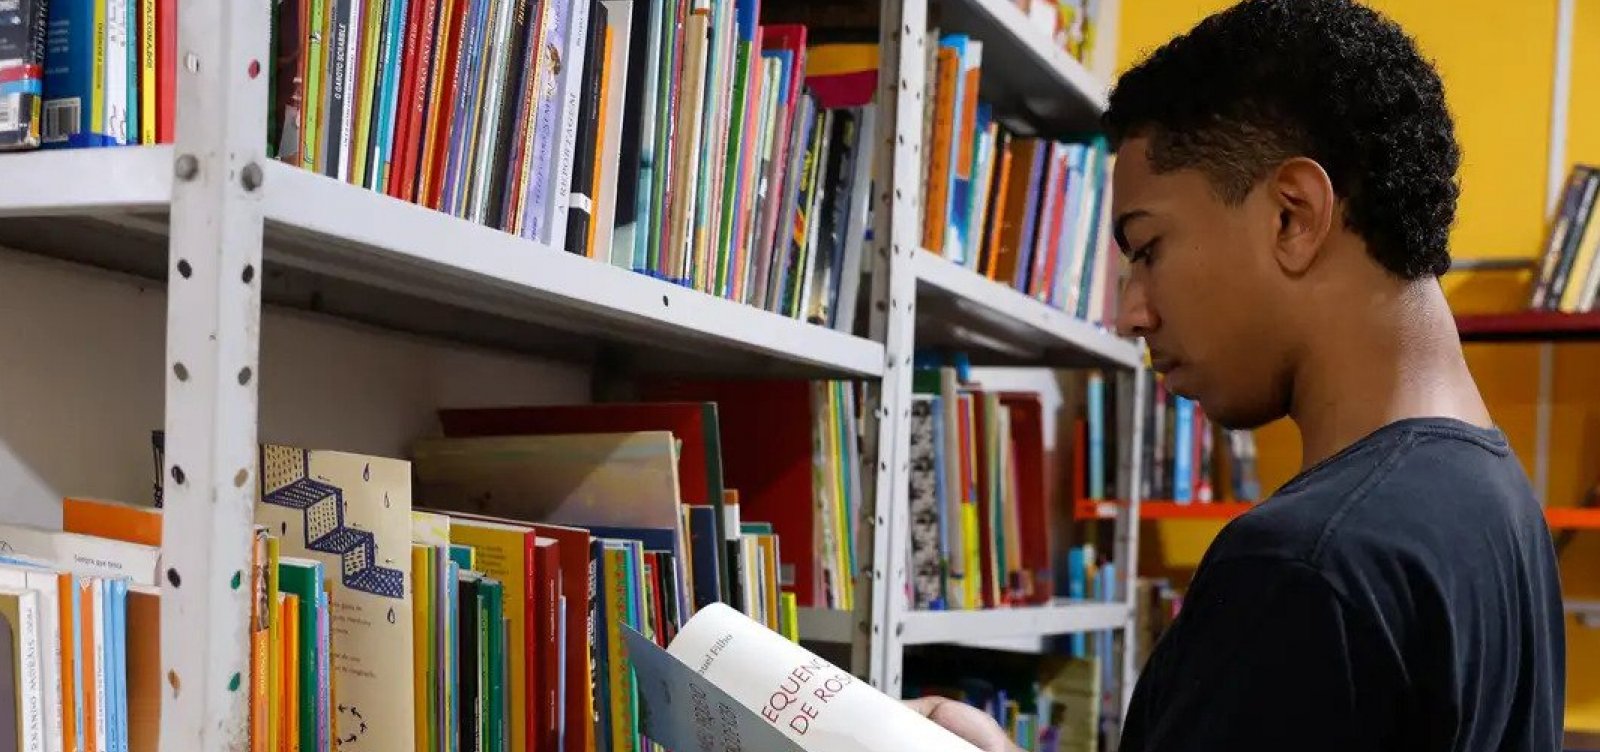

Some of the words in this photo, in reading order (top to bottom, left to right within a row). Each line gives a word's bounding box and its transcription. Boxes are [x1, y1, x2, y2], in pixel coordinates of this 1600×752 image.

[338, 23, 347, 61] SCRABBLE
[335, 63, 344, 92] GAROTO
[560, 93, 577, 197] REPORTAGEM
[710, 633, 733, 656] Filho
[789, 702, 819, 735] DE
